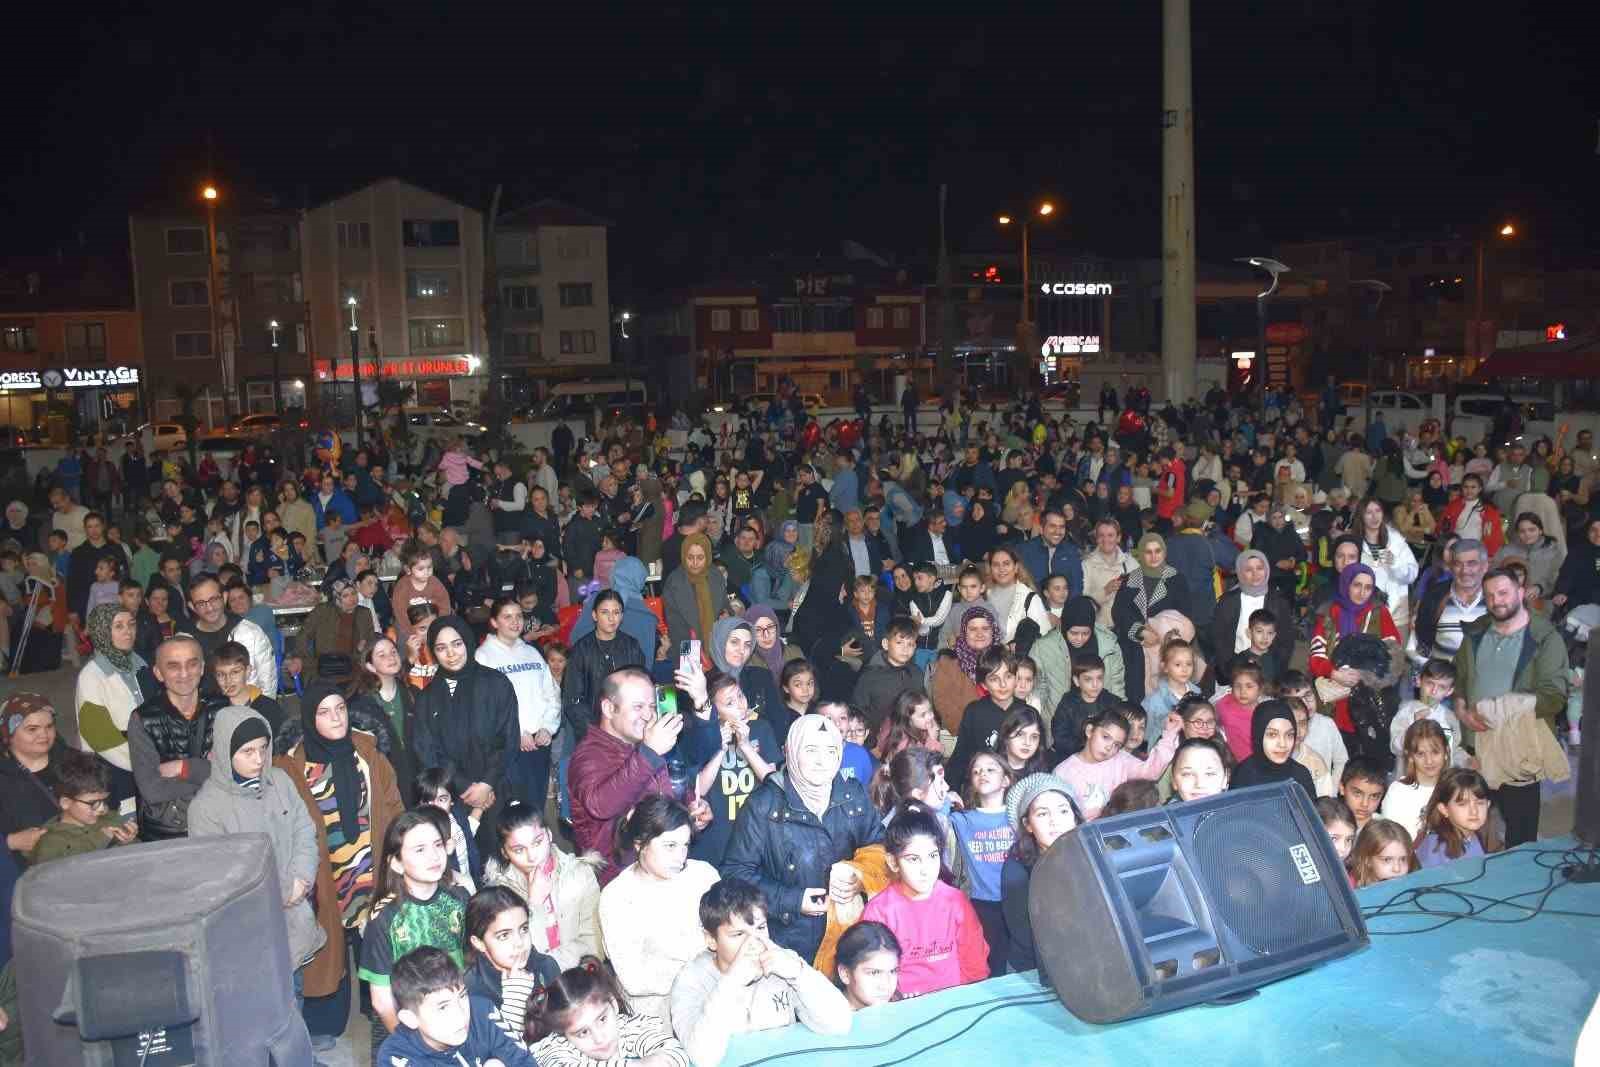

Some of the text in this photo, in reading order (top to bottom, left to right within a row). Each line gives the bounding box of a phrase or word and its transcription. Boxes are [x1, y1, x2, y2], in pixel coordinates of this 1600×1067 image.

[720, 767, 755, 796] DO
[728, 793, 749, 821] IT
[1291, 846, 1318, 882] MCS
